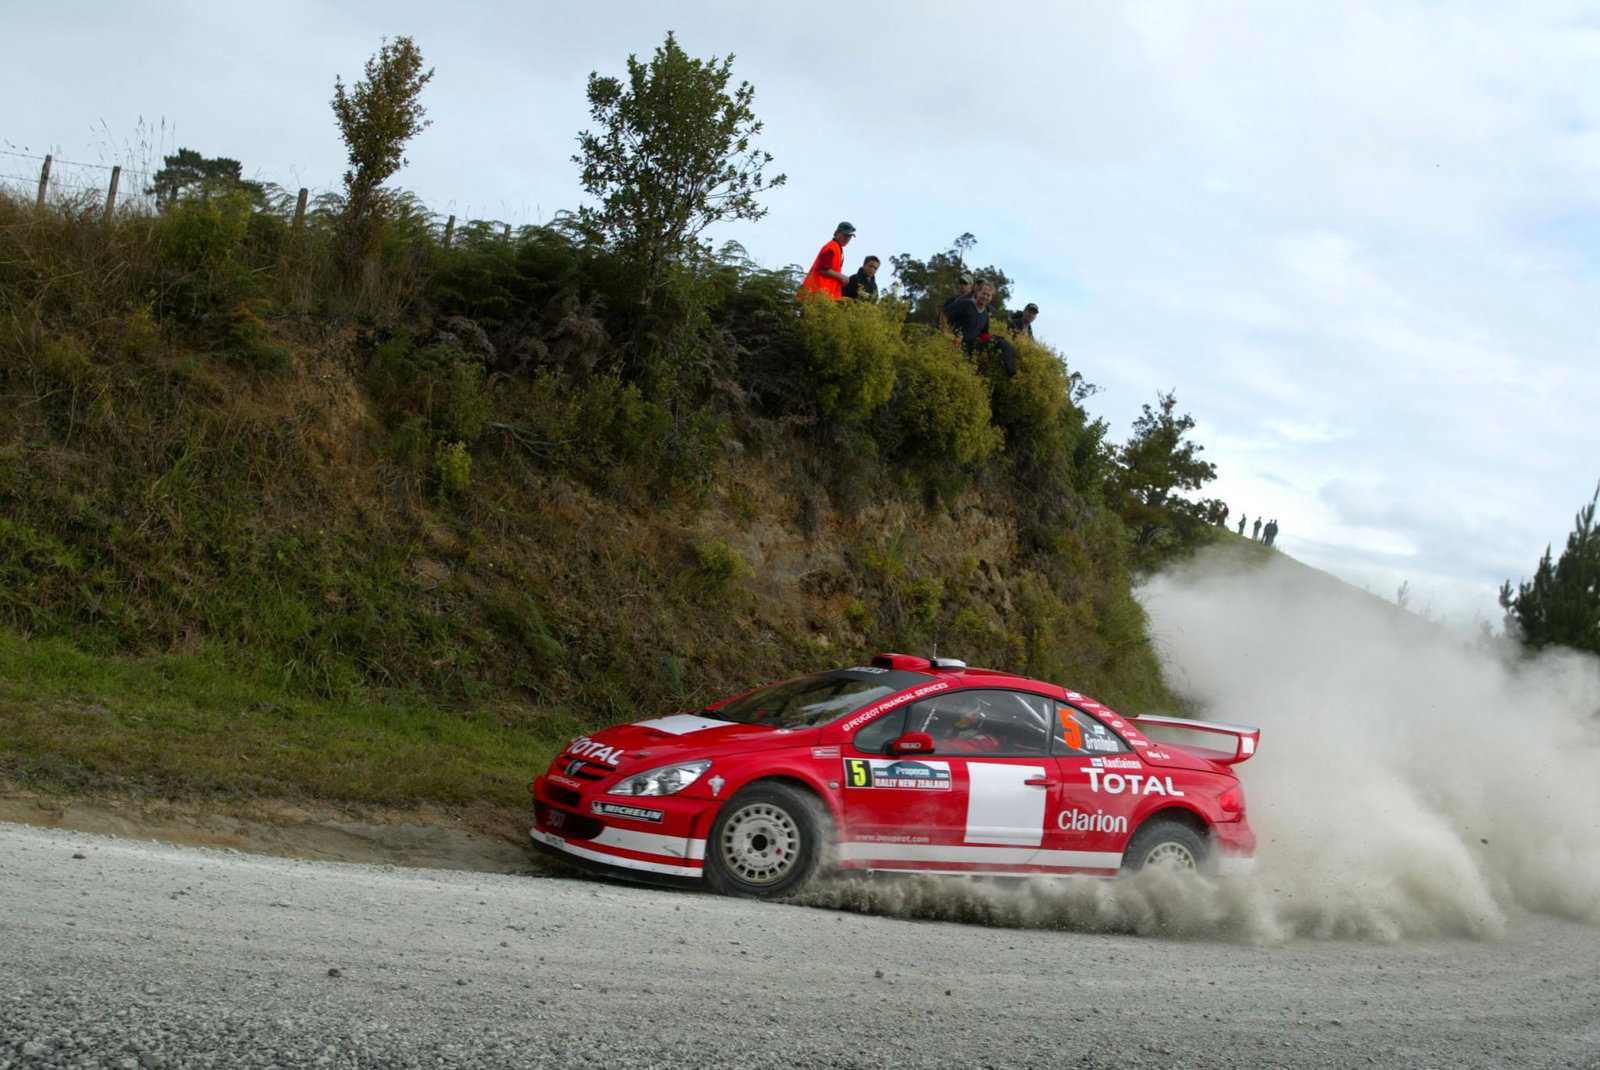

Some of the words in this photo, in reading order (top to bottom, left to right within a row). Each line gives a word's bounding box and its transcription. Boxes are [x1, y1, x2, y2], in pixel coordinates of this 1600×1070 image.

[849, 708, 881, 727] PEUGEOT
[879, 693, 915, 712] FINANCIAL
[914, 682, 948, 697] SERVICES
[1058, 708, 1083, 750] 5
[566, 736, 624, 765] TOTAL
[850, 760, 867, 787] 5
[875, 778, 897, 788] RALLY
[898, 779, 916, 788] NEW
[917, 779, 950, 789] ZEALAND
[1080, 767, 1185, 797] TOTAL
[604, 804, 662, 819] MICHELIN
